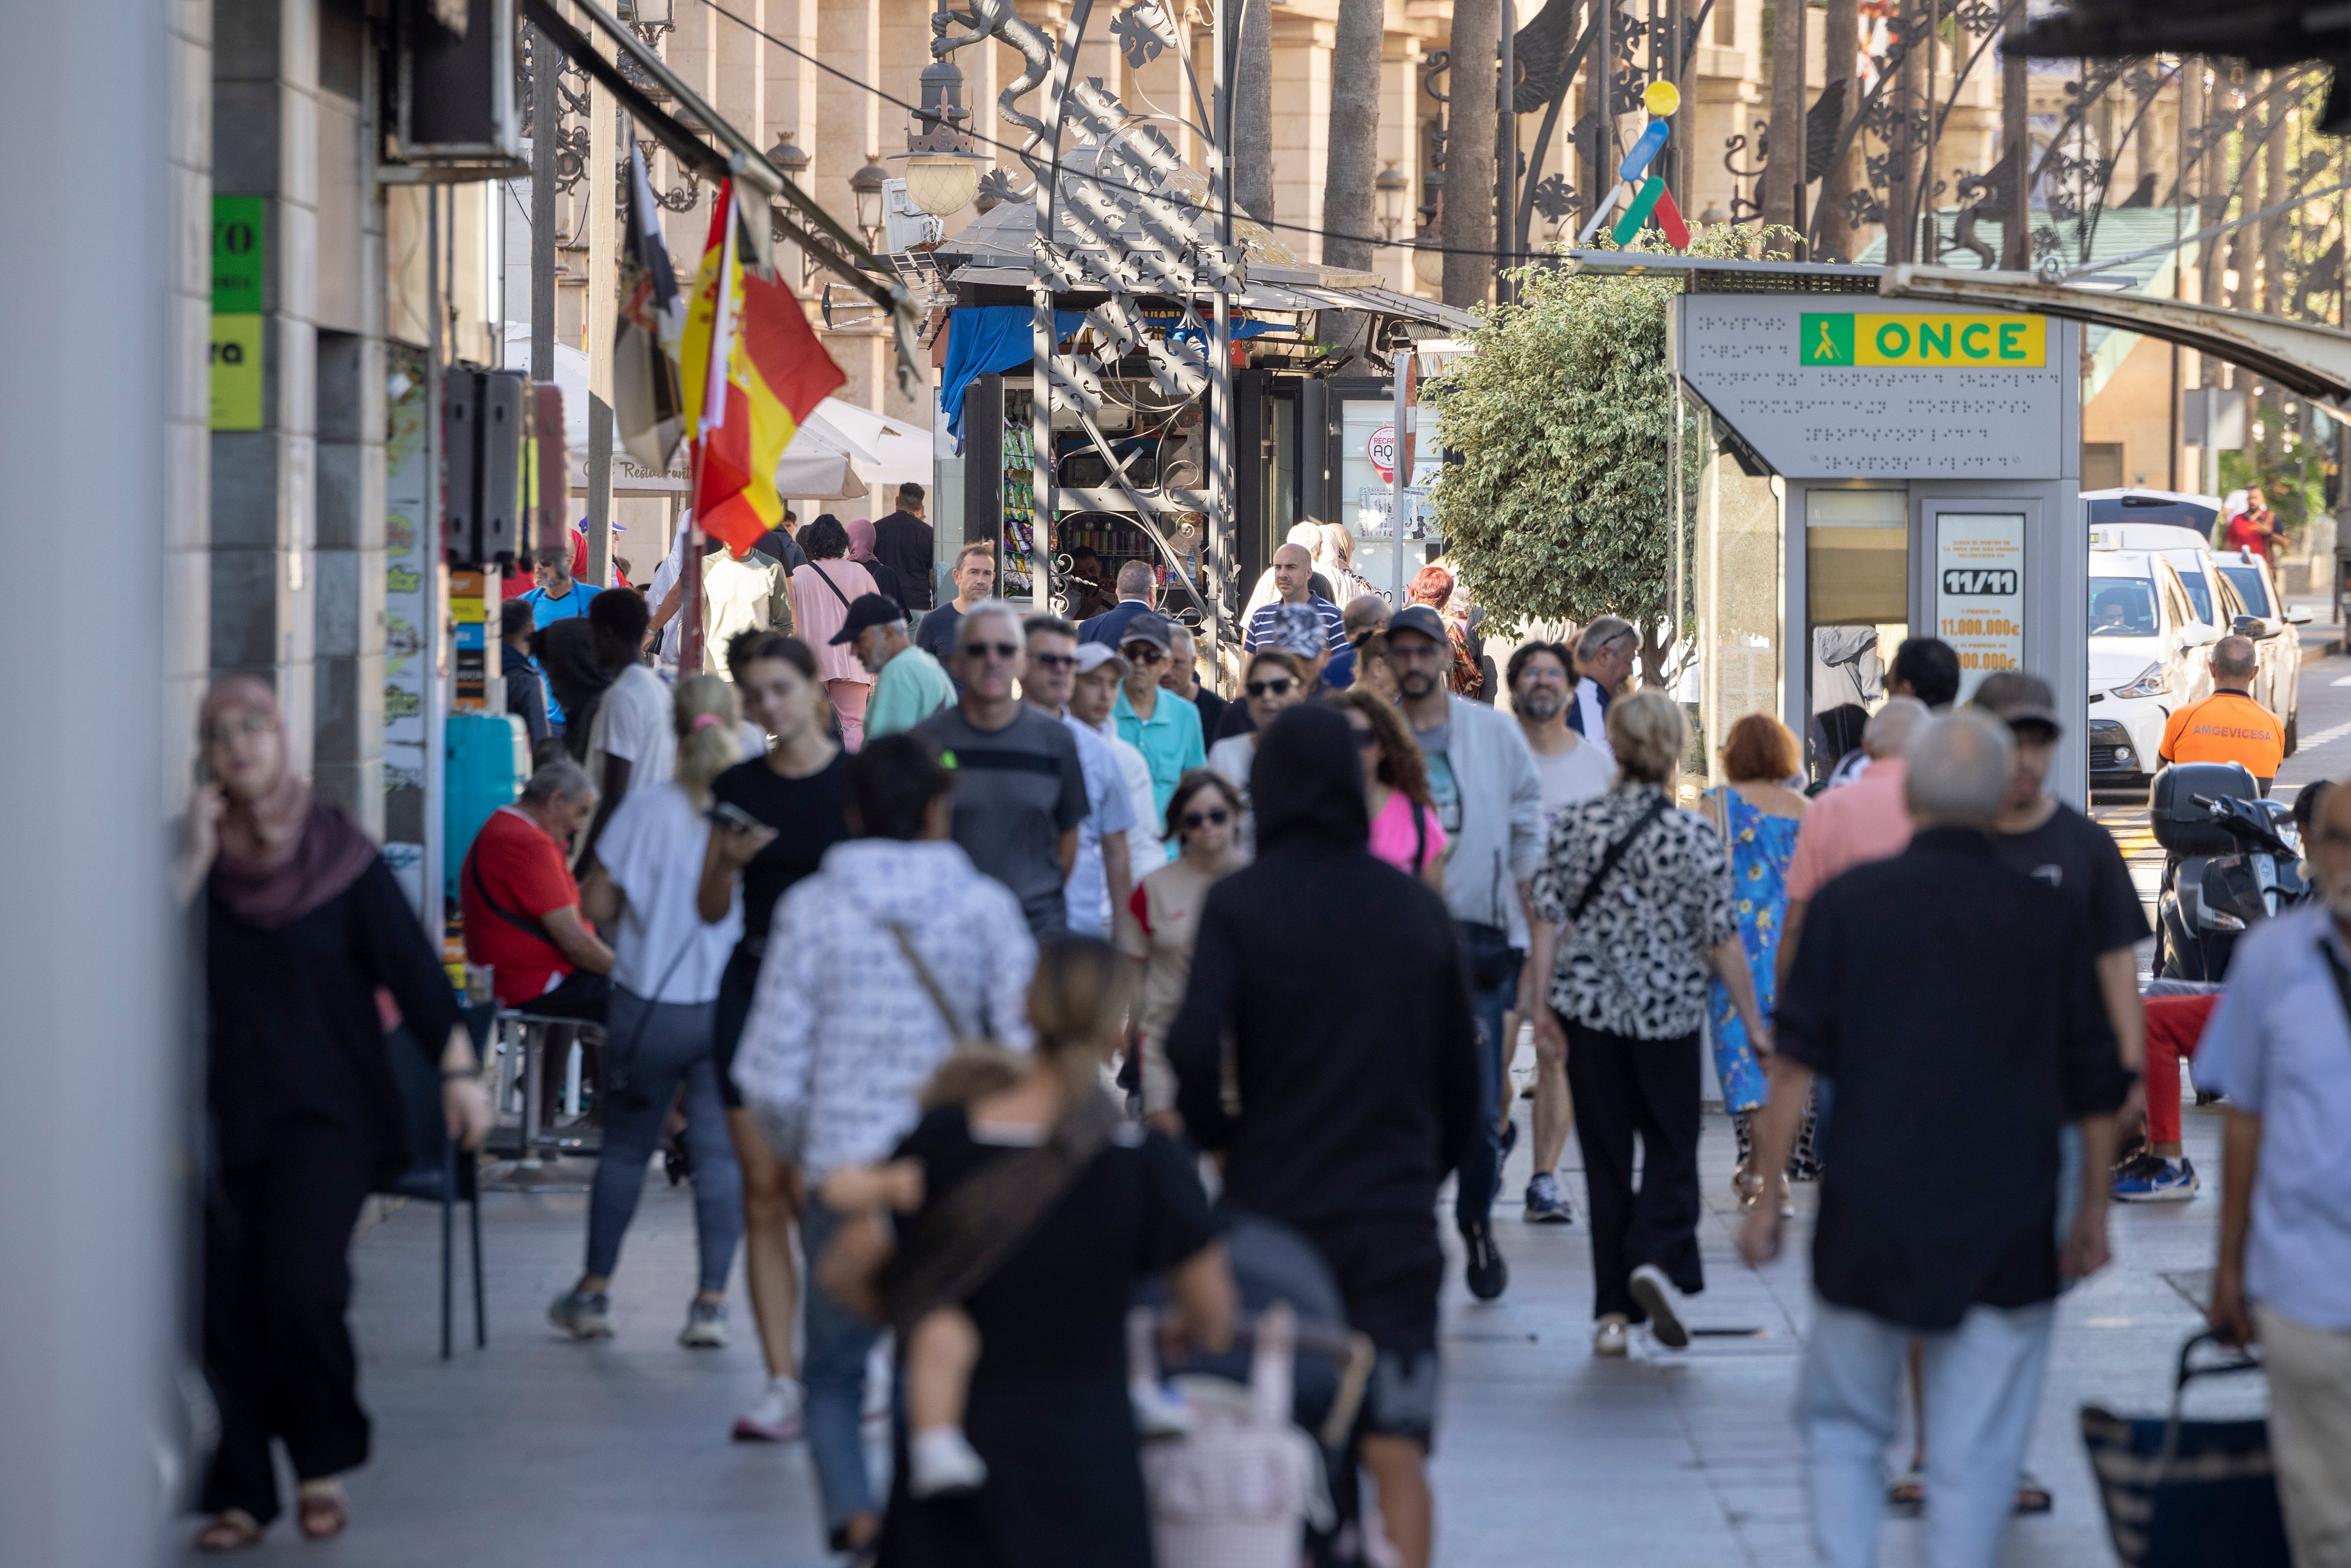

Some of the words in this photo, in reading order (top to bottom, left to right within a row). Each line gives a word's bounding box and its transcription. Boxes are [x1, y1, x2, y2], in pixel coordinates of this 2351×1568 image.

[1876, 322, 2027, 359] ONCE
[1946, 571, 2014, 593] 11/11
[1941, 619, 2020, 636] 11.000.000€
[2193, 724, 2271, 741] AMGEVICESA
